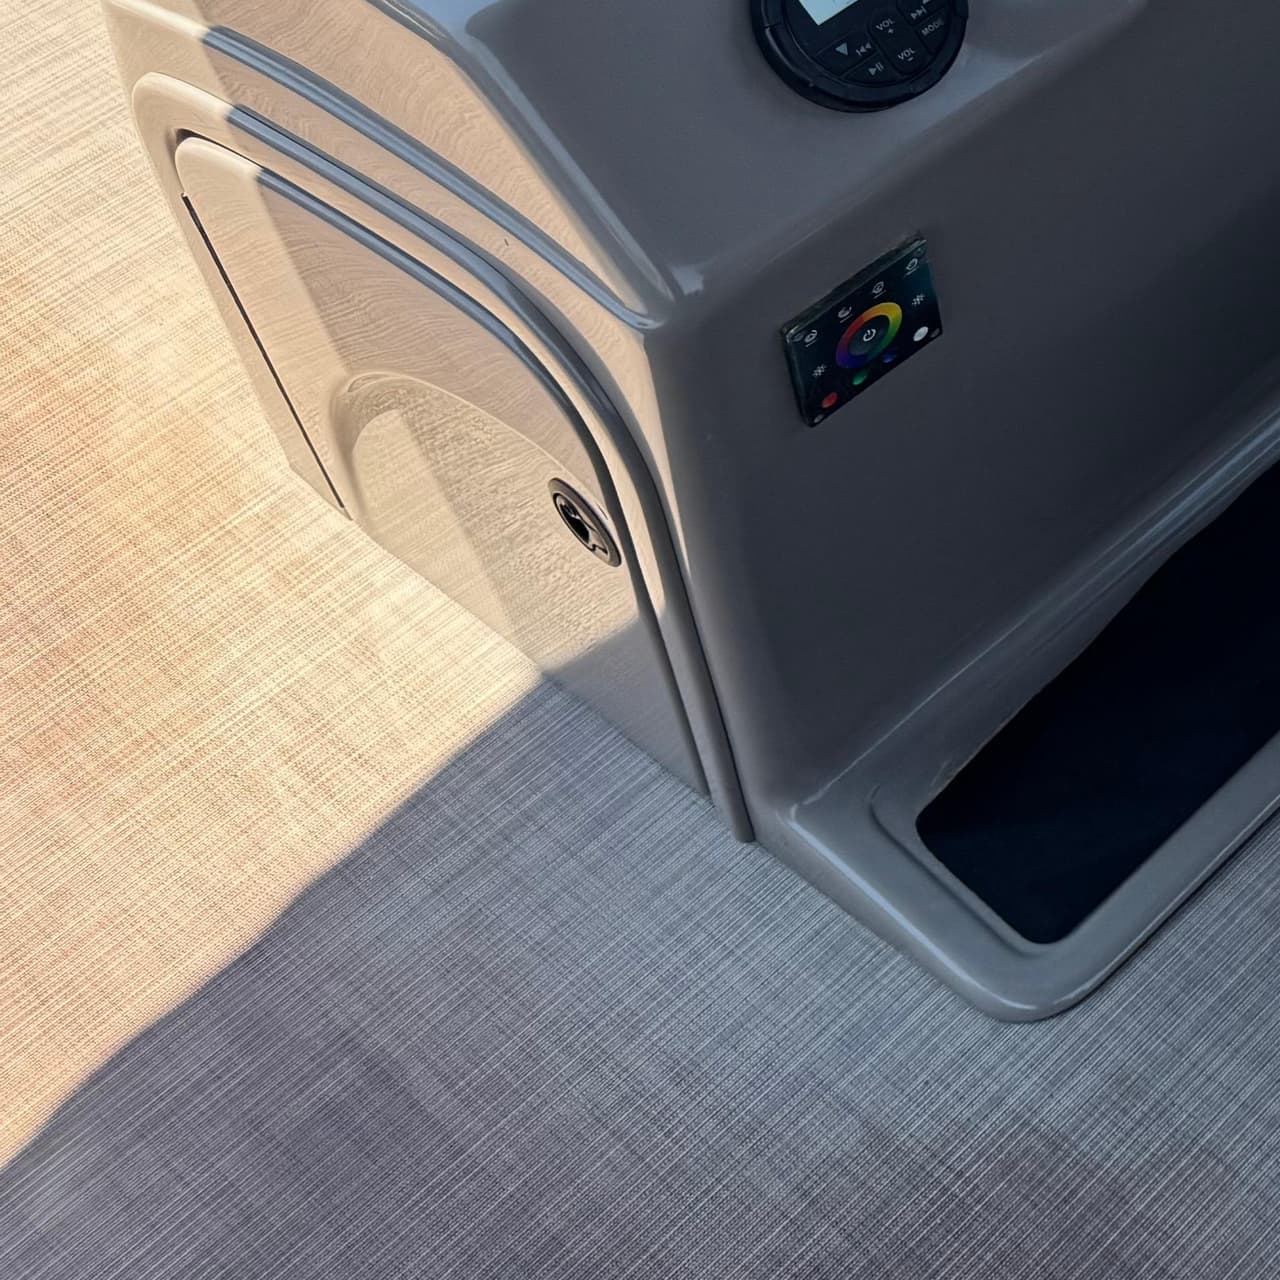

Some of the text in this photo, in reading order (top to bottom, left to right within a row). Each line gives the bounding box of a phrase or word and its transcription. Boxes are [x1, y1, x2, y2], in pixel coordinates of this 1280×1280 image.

[876, 18, 896, 31] VOL
[921, 18, 945, 36] MODE
[897, 47, 916, 61] VOL
